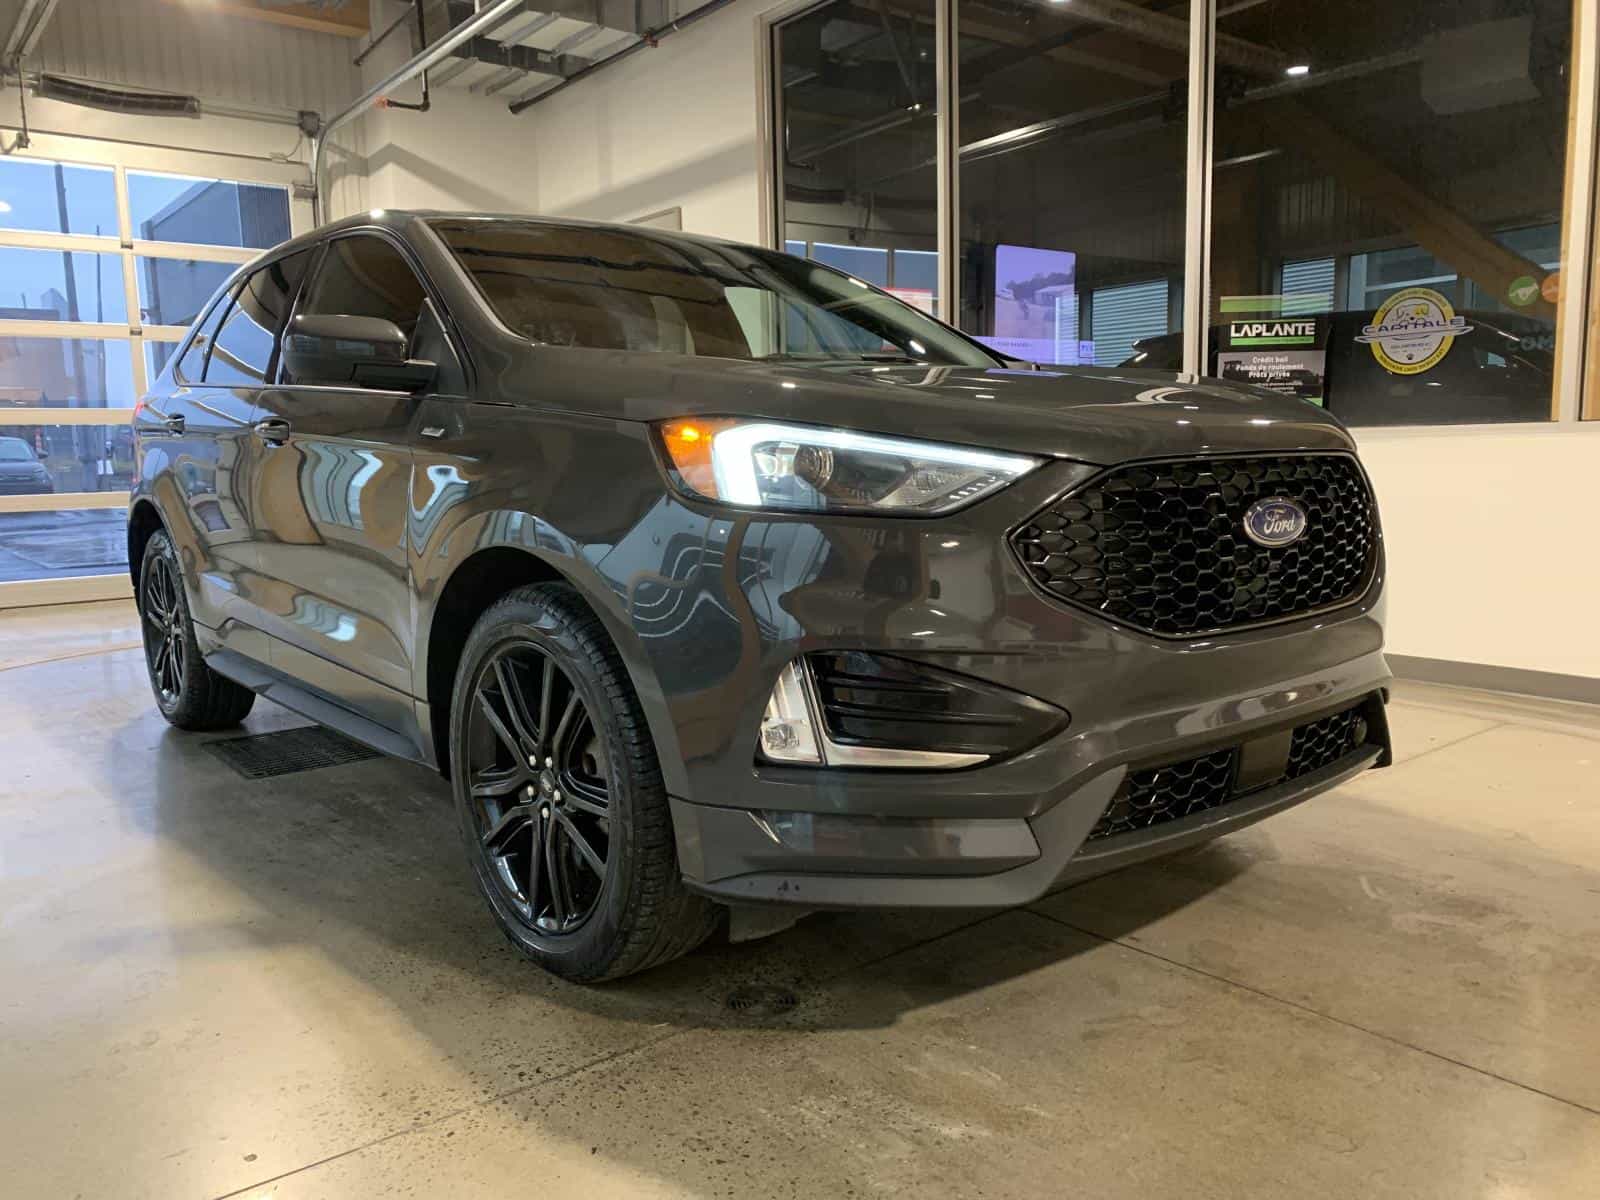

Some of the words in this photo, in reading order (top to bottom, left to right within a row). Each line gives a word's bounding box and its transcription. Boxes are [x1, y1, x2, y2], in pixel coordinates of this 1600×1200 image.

[1230, 322, 1316, 337] LAPLANTE
[1362, 315, 1465, 335] CAPITALE
[1263, 508, 1297, 535] Ford
